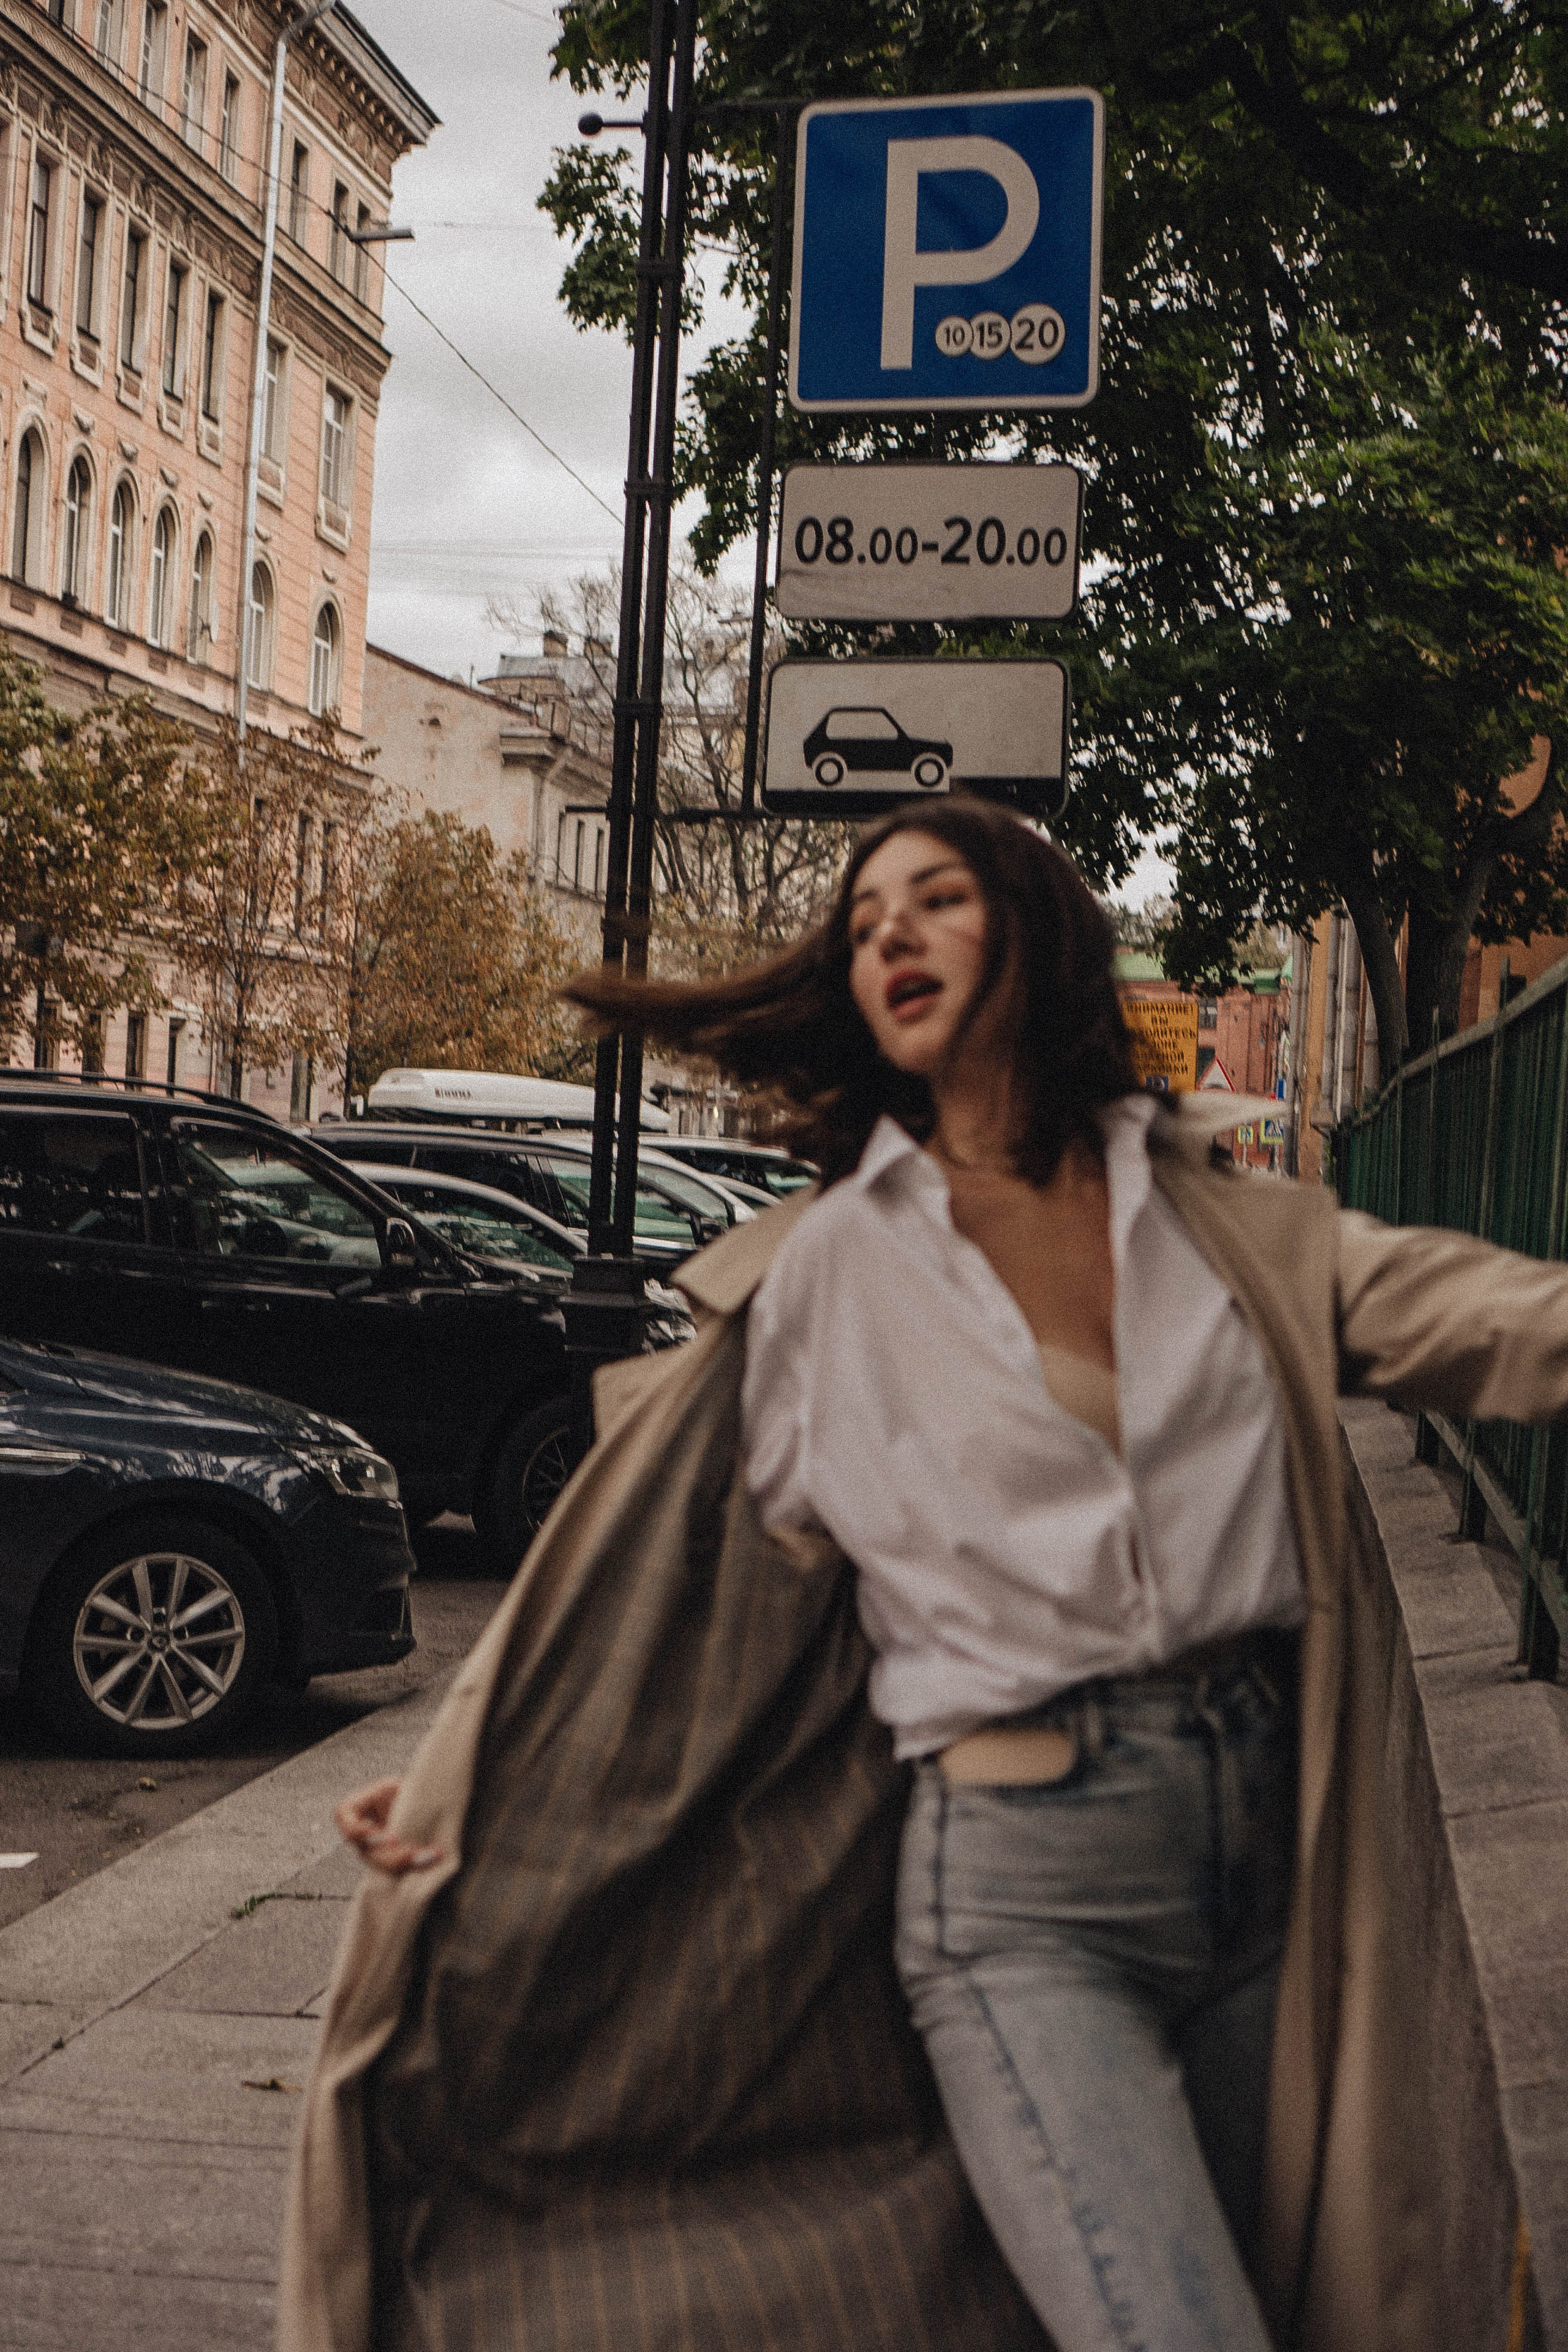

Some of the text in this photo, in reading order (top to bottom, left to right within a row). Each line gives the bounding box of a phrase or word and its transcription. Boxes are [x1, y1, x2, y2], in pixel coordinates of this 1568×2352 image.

[881, 135, 1040, 370] P
[943, 317, 1060, 351] 10 15 20
[796, 516, 1068, 565] 08.00-20.00
